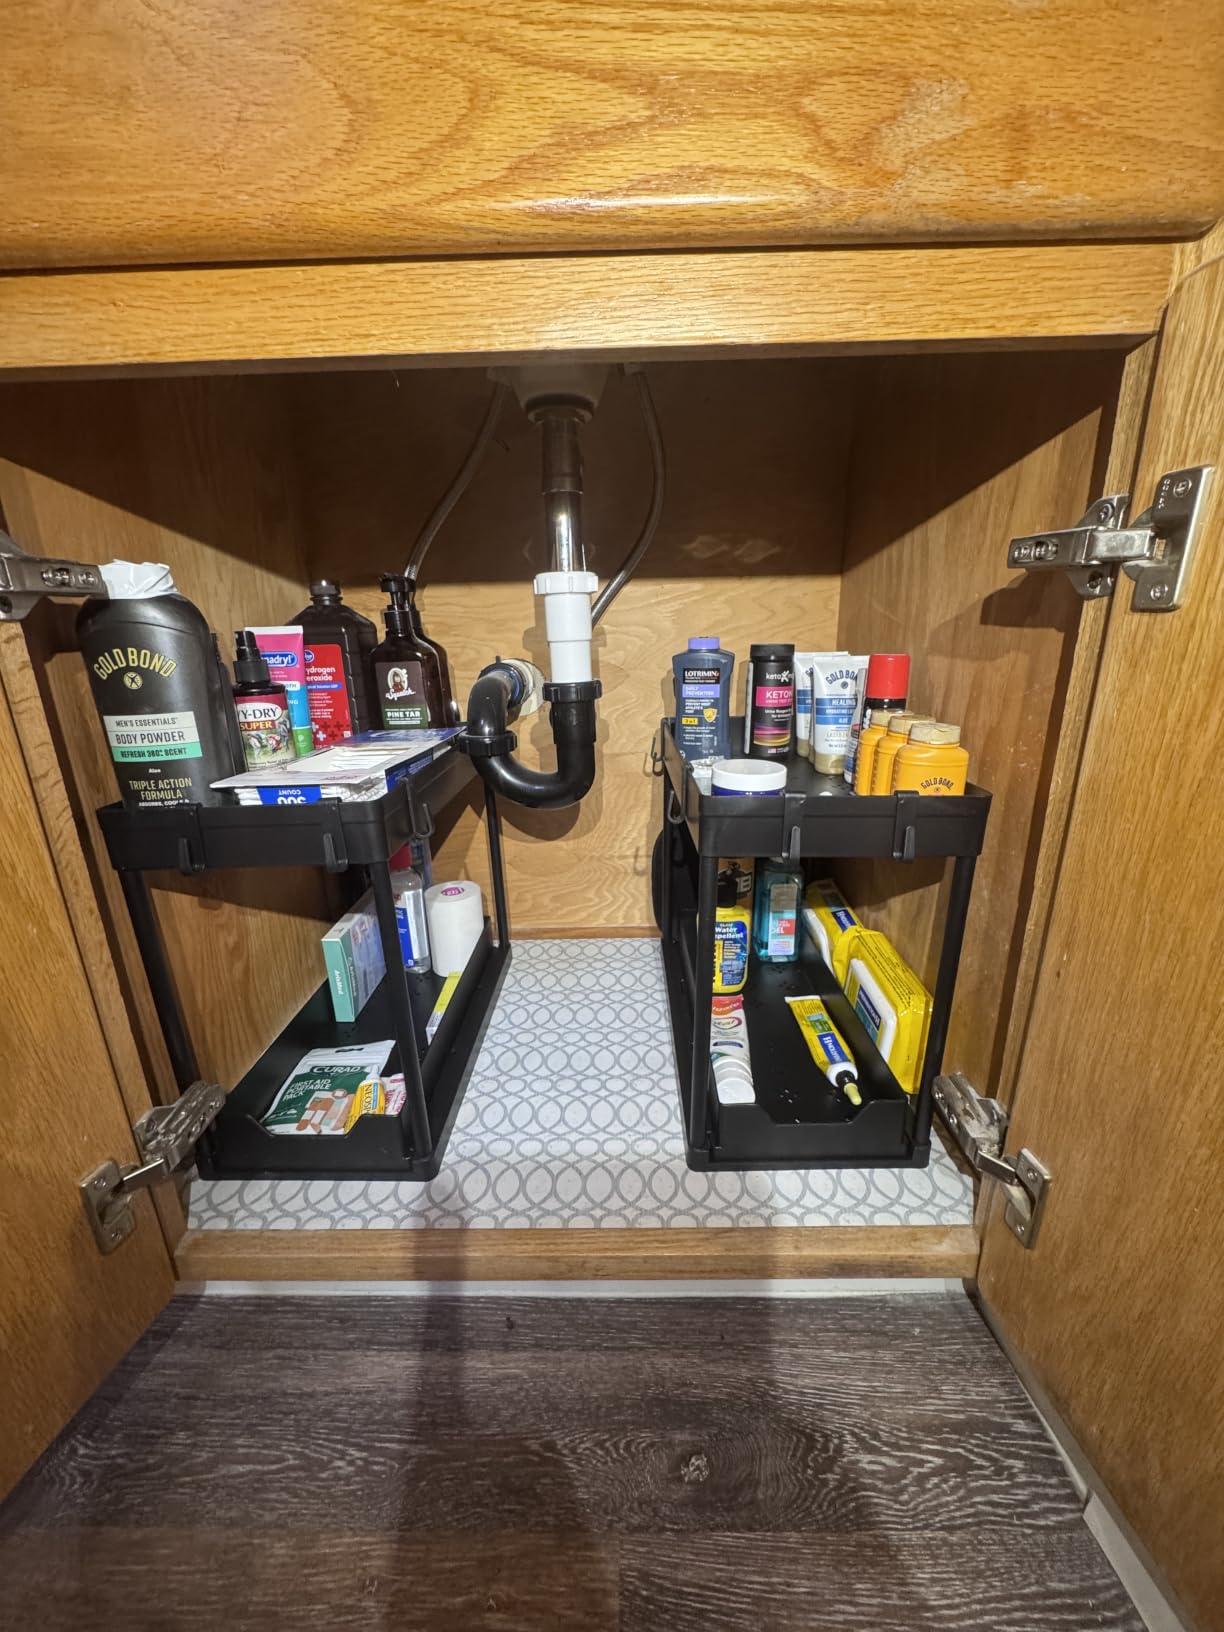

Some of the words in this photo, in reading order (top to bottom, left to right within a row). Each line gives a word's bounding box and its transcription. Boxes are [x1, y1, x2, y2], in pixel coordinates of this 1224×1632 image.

[94, 648, 126, 680] GOLD
[128, 648, 176, 676] BOND
[265, 655, 291, 666] nadryl
[306, 666, 336, 675] ydrogen
[826, 670, 843, 684] GOLD
[241, 708, 276, 720] Y-DRY
[116, 719, 134, 728] MEN'S
[136, 718, 177, 726] ESSENTIALS
[240, 721, 272, 730] SUPER
[116, 733, 137, 744] BODY
[140, 731, 186, 743] POWDER
[120, 750, 146, 758] REFRESH
[165, 748, 187, 756] SCENT
[129, 780, 156, 790] TRIPLE
[158, 777, 192, 789] ACTION
[920, 778, 937, 790] GOLD
[938, 778, 954, 790] BOND
[140, 790, 183, 800] FORMULA
[286, 1084, 331, 1094] PORTABLE
[282, 1092, 303, 1102] PACK
